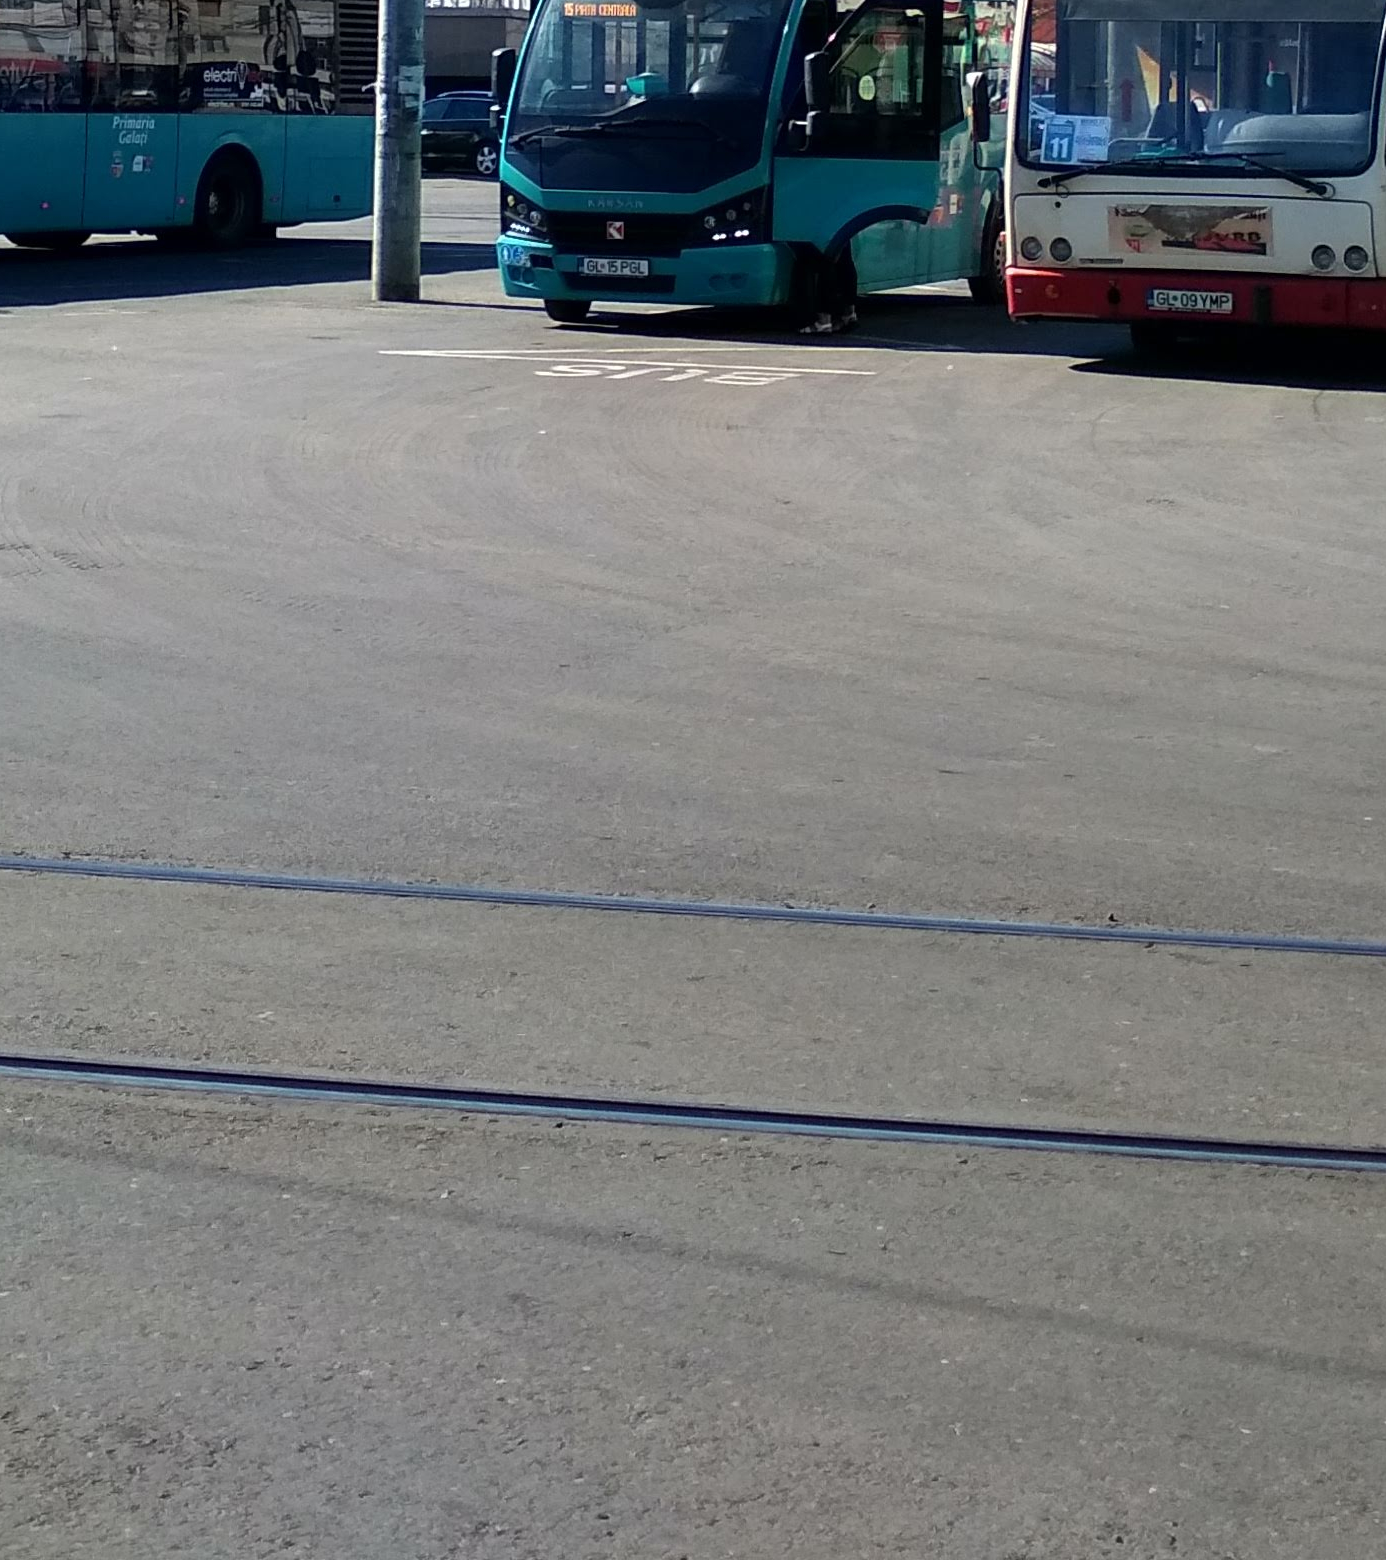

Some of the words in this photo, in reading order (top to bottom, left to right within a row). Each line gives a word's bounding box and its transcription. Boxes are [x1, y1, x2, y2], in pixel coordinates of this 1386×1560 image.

[564, 3, 573, 16] 15
[1050, 137, 1069, 158] 11
[587, 260, 602, 273] GL
[606, 260, 619, 273] 15
[620, 261, 646, 275] PGL
[1156, 292, 1174, 306] GL
[1180, 293, 1198, 307] 09
[1199, 295, 1230, 308] YMP
